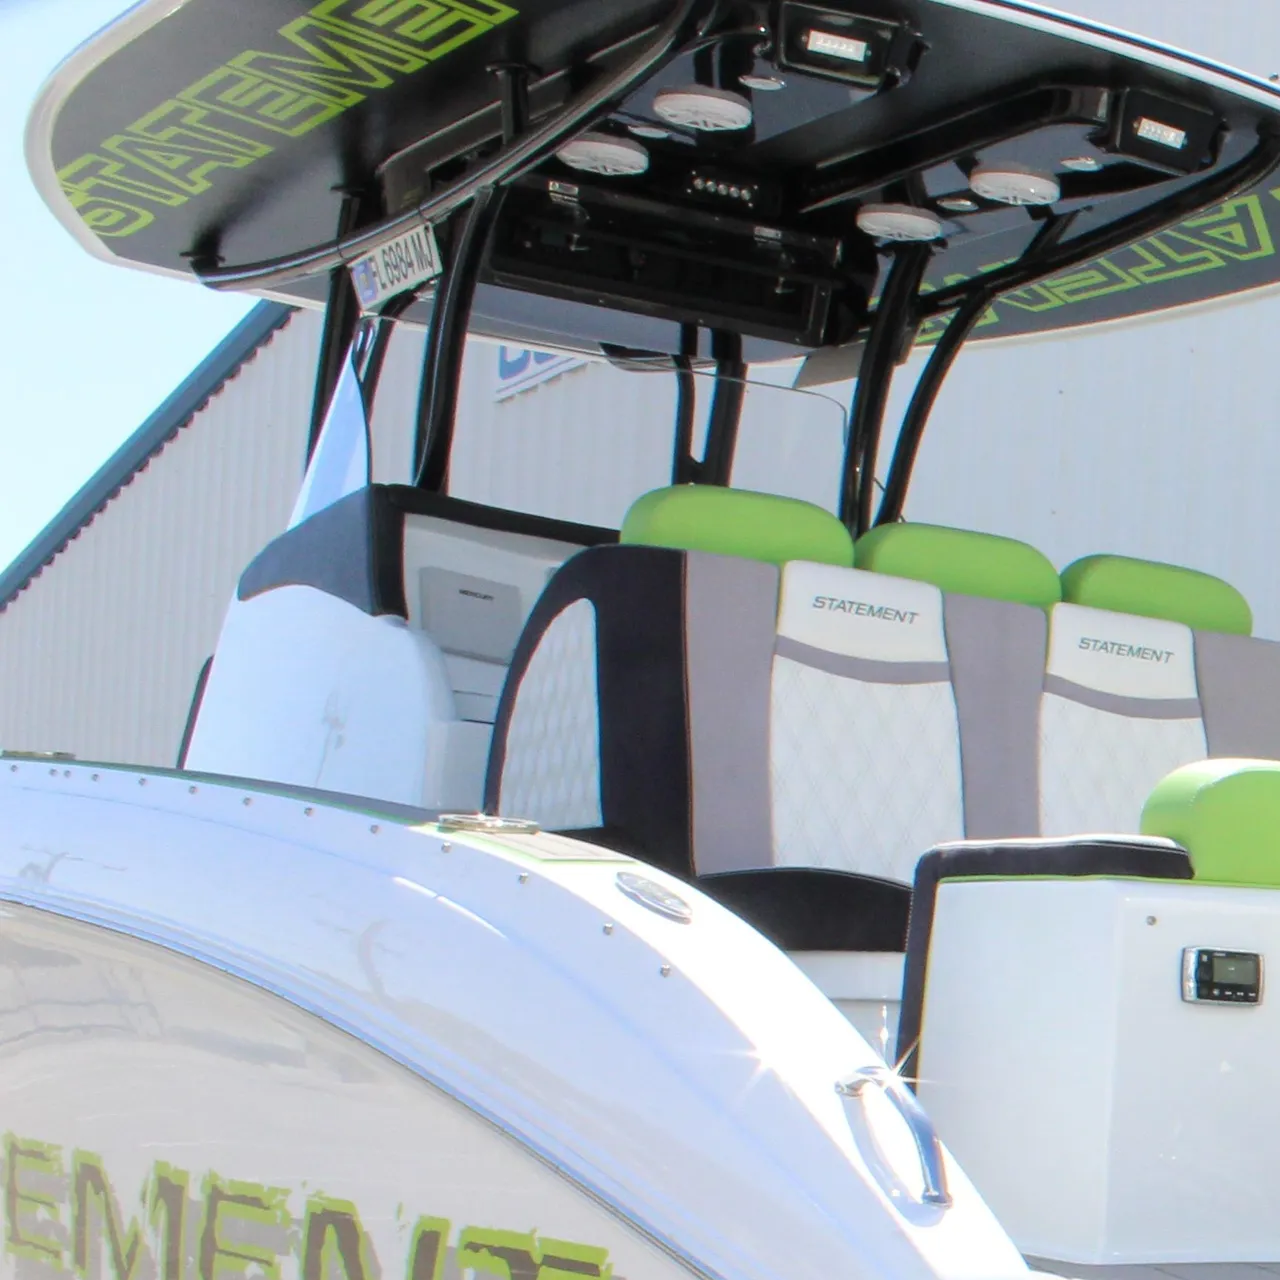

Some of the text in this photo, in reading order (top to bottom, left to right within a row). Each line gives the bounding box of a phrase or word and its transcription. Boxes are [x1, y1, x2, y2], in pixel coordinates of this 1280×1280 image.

[381, 239, 416, 287] 6984
[812, 595, 920, 625] STATEMENT
[1078, 636, 1176, 664] STATEMENT
